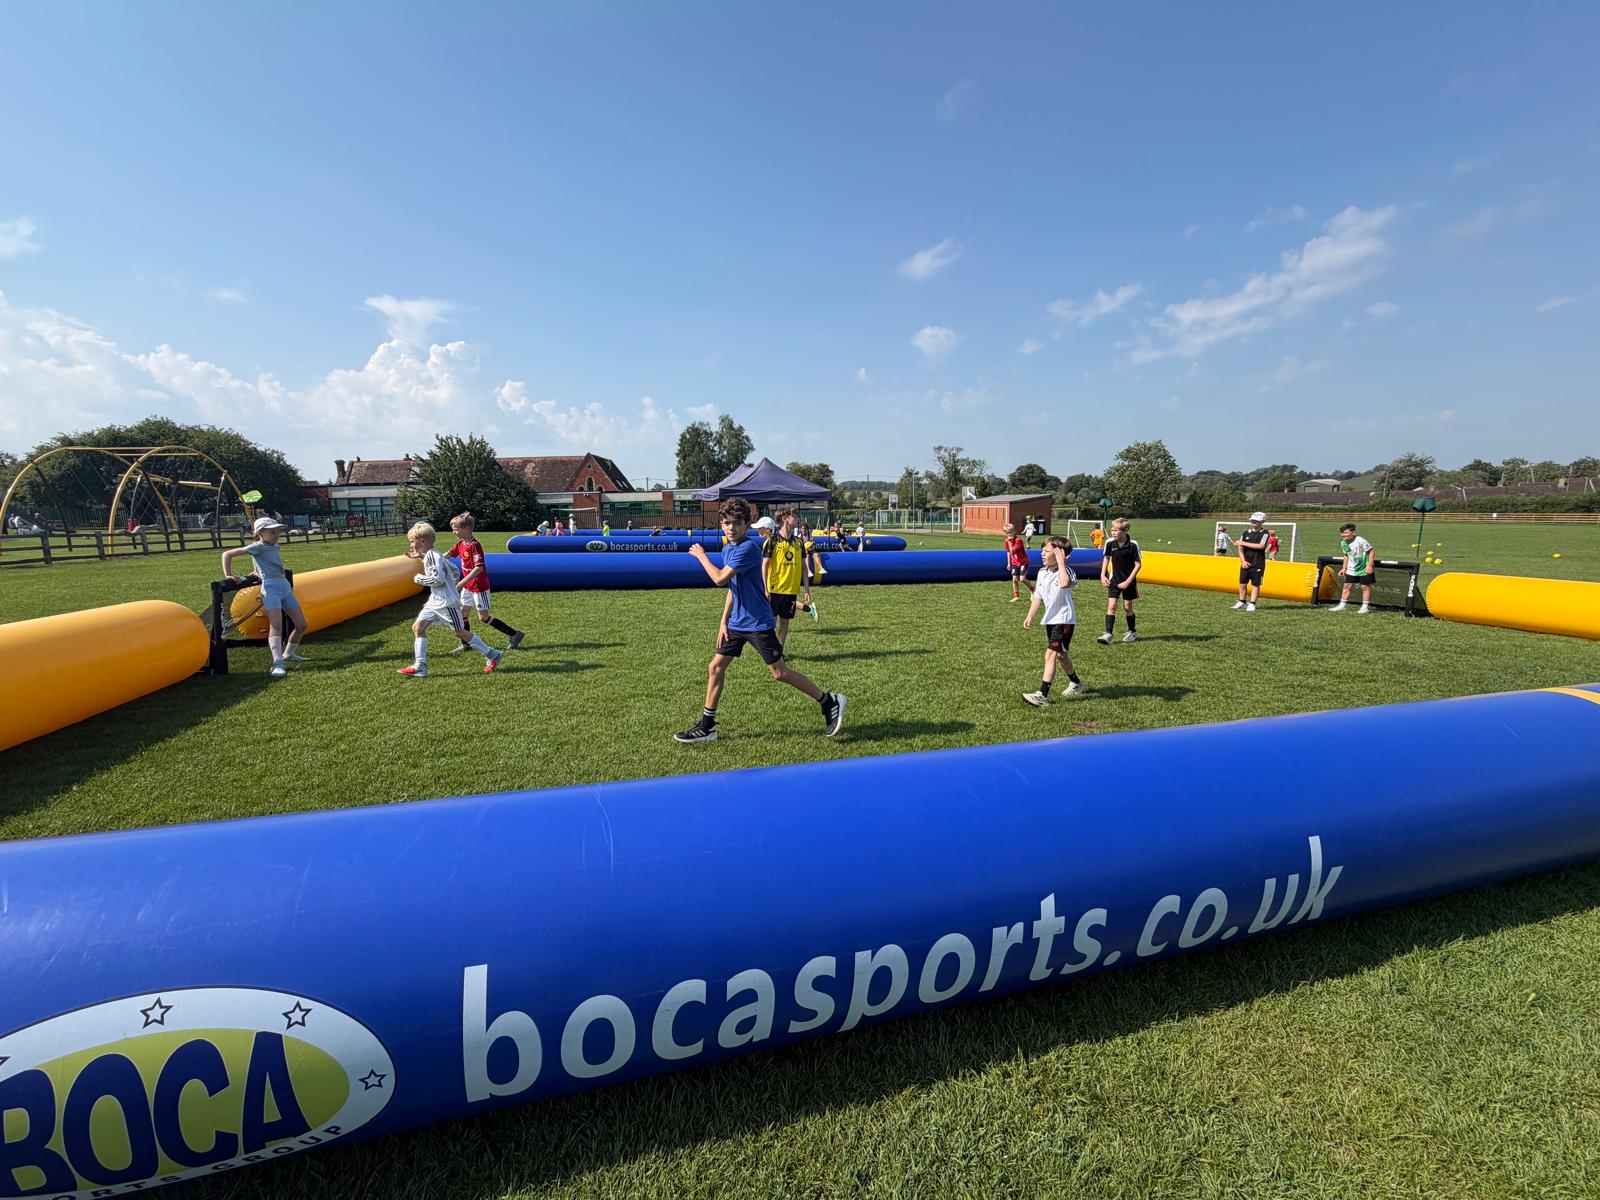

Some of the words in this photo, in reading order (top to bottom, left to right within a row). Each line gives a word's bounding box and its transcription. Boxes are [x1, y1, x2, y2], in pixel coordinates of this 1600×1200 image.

[610, 541, 678, 552] bocasports.co.uk
[463, 835, 1344, 1103] bocasports.co.uk
[0, 1031, 312, 1196] BOCA
[211, 1125, 342, 1171] GROUP
